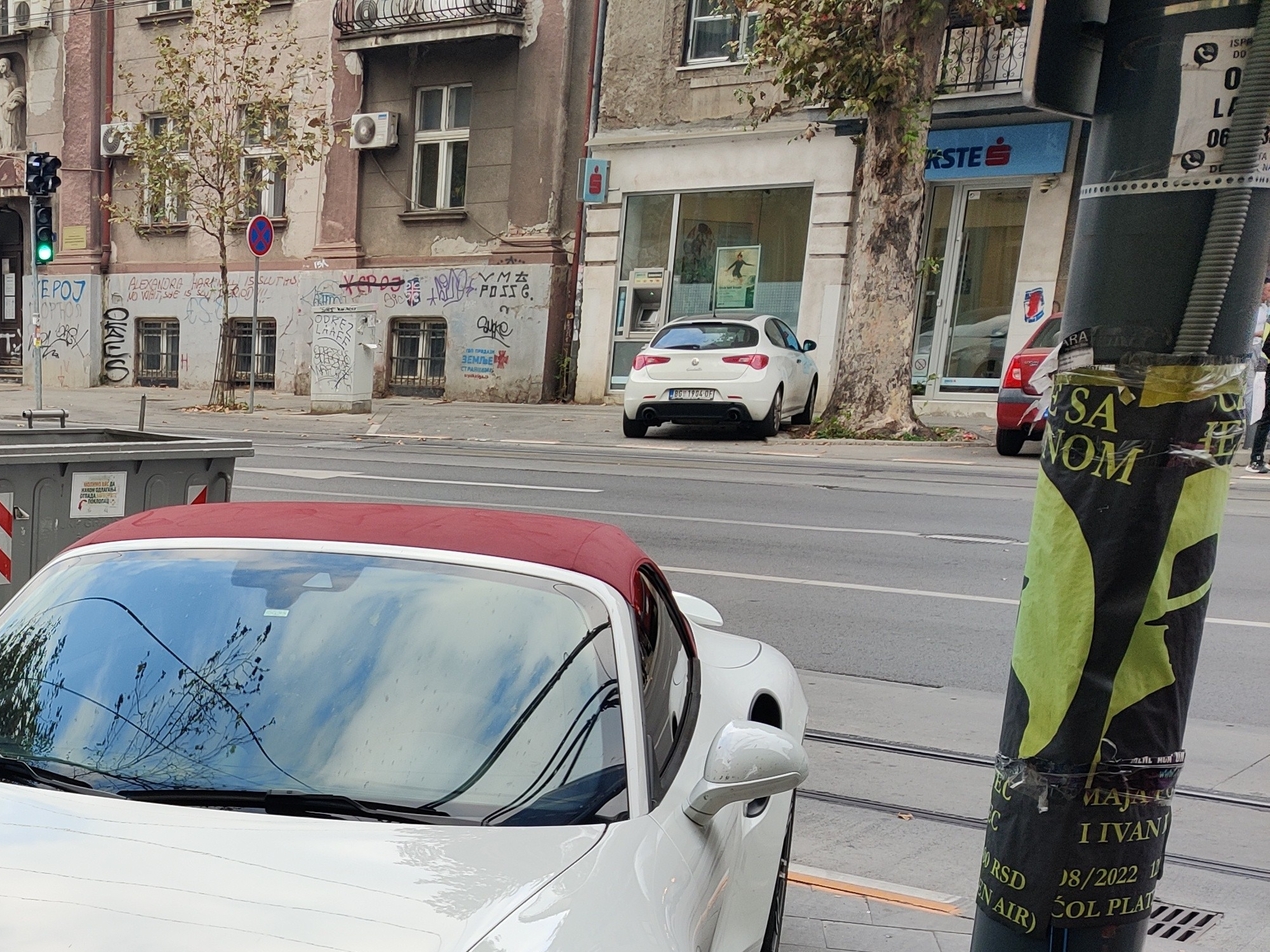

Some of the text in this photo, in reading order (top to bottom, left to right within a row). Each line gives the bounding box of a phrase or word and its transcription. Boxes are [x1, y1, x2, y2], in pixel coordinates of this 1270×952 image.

[925, 146, 984, 169] RSTE
[1064, 386, 1119, 434] SA
[991, 857, 1026, 891] RSD
[992, 896, 1037, 935] AIR)
